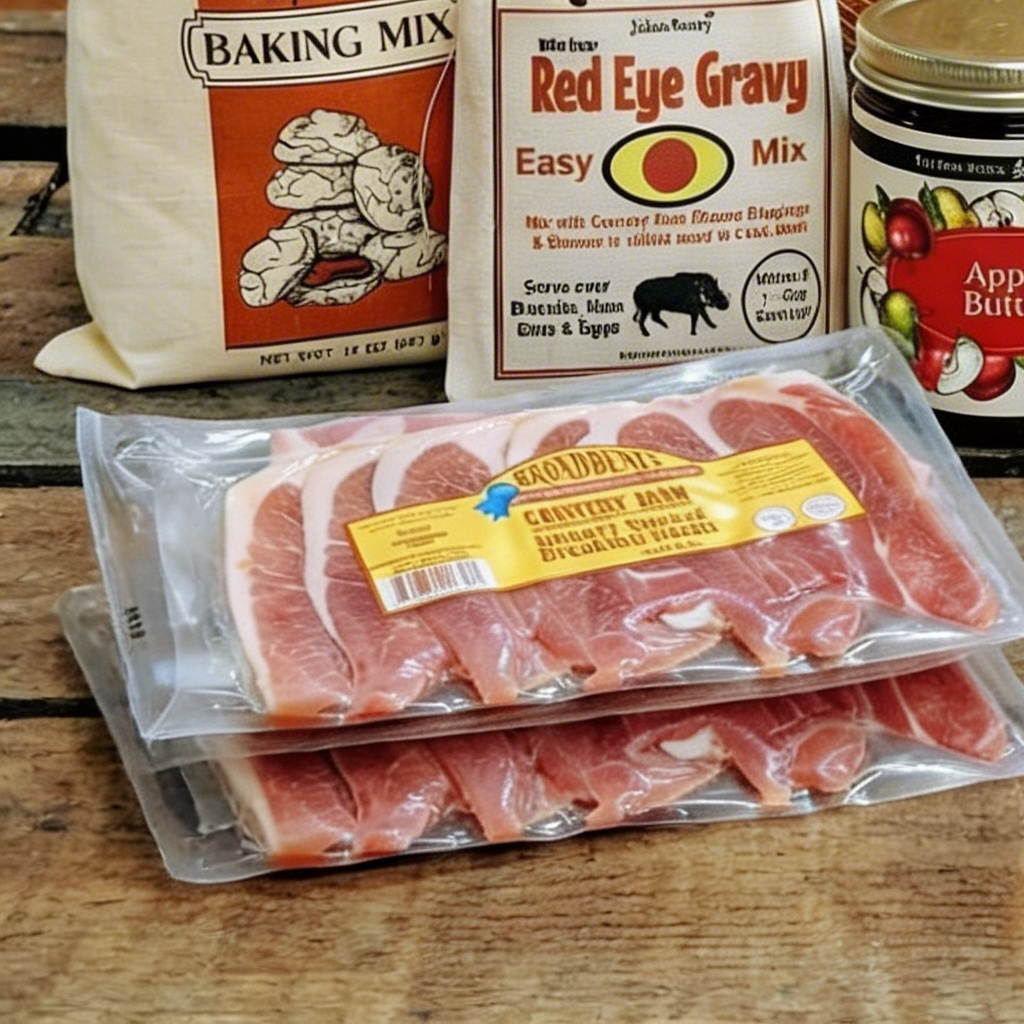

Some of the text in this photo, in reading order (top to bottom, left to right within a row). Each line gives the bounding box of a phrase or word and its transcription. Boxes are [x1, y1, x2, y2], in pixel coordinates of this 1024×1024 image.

[204, 8, 455, 66] BAKING MIX
[530, 50, 808, 123] Red Eye Gravy
[516, 136, 807, 182] Easy Mix
